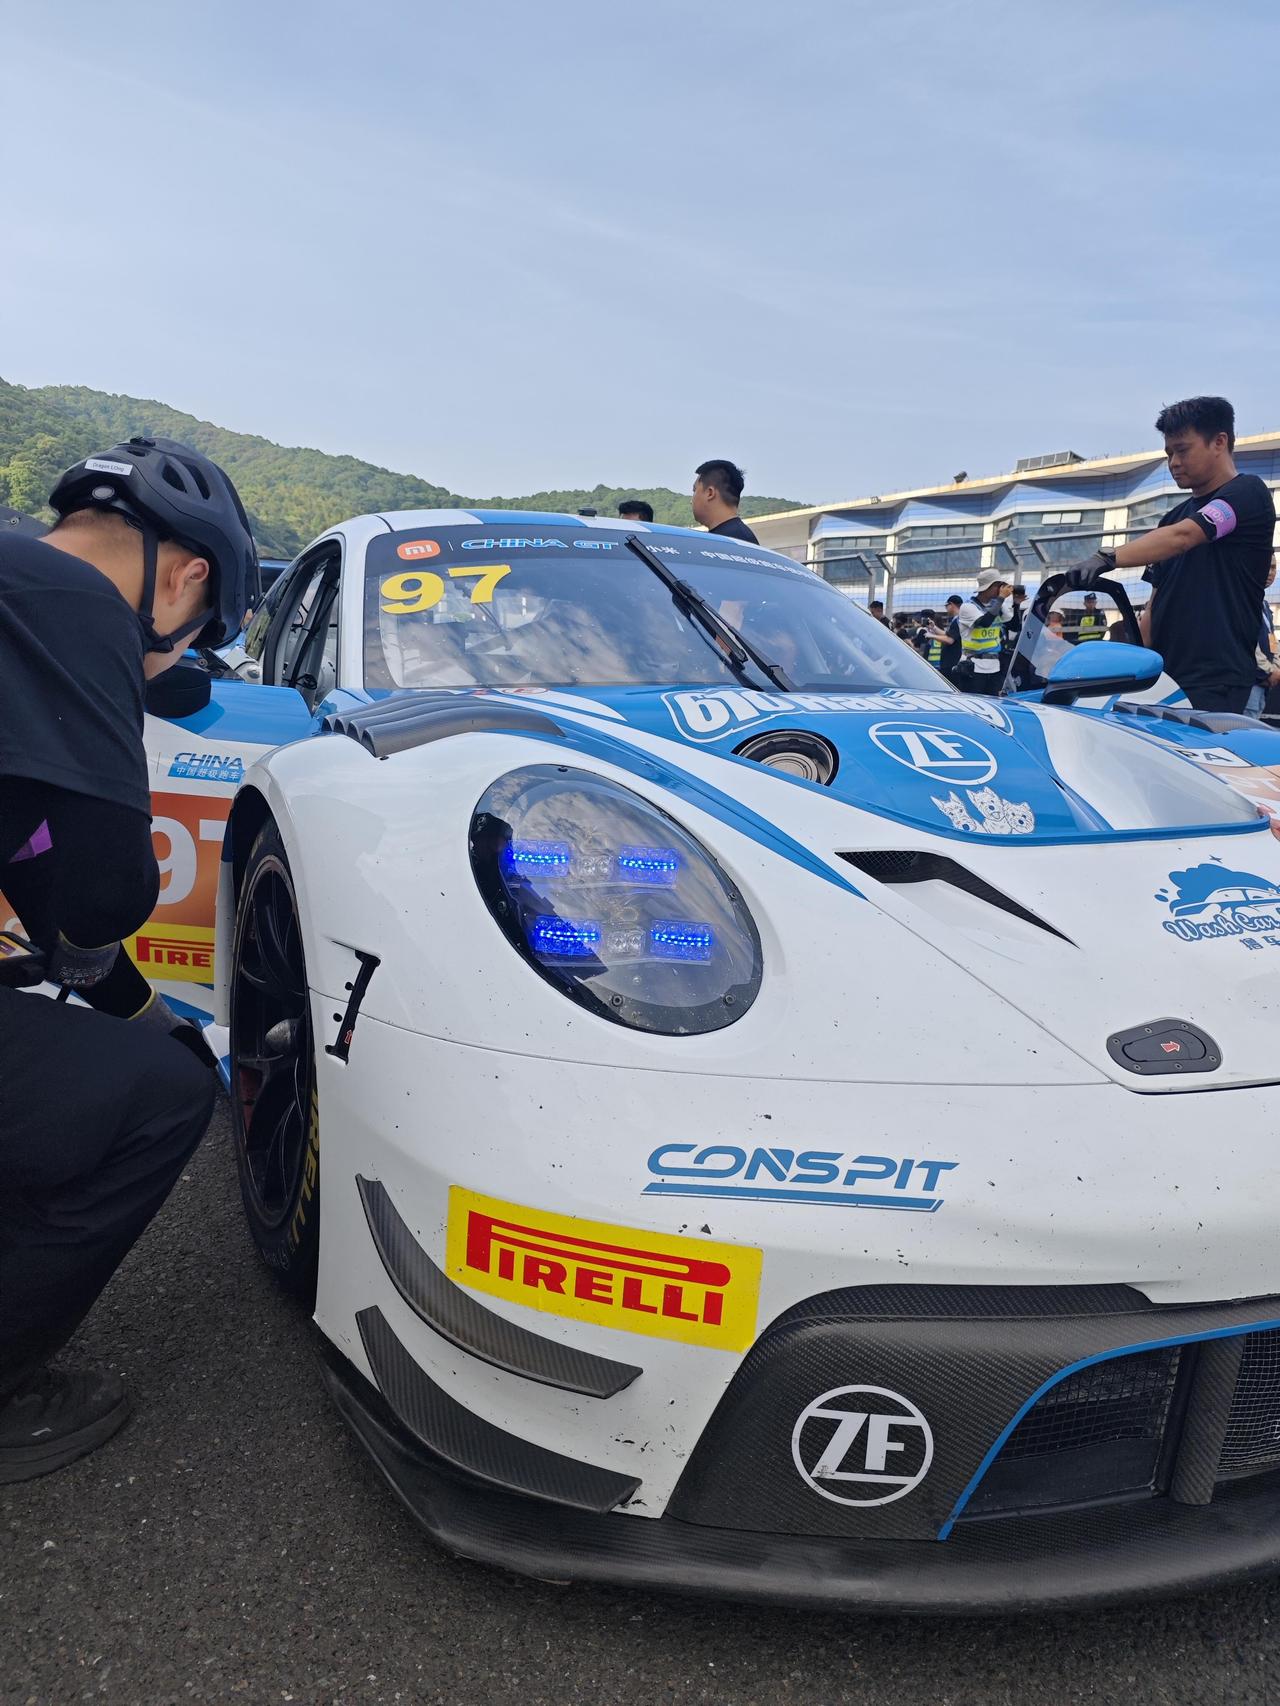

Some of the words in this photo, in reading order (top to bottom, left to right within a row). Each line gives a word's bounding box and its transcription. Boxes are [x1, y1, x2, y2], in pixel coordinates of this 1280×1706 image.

[460, 538, 569, 550] CHINA
[573, 539, 619, 550] GT
[379, 563, 512, 615] 97
[673, 689, 796, 733] 610
[795, 687, 1007, 728] Racing
[174, 751, 243, 770] CHINA
[646, 1143, 960, 1192] CONSPIT
[465, 1209, 732, 1326] PIRELLI
[806, 1407, 924, 1485] ZF
